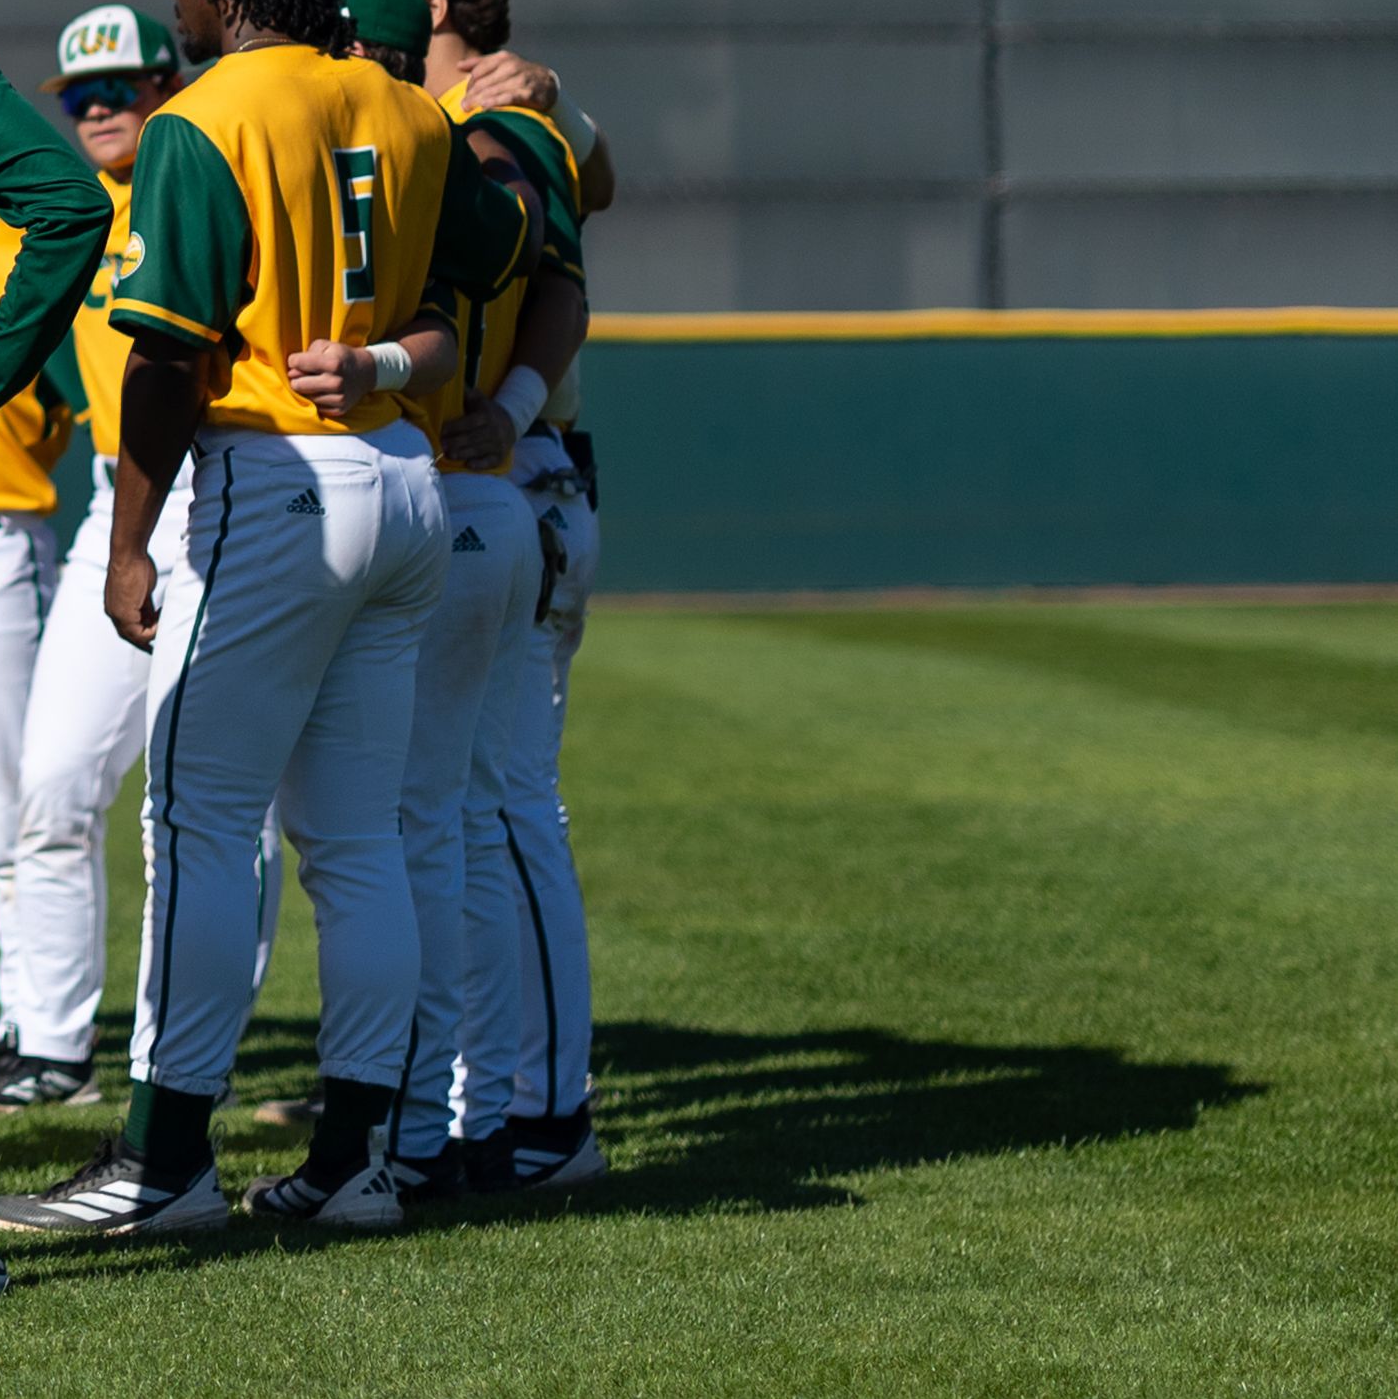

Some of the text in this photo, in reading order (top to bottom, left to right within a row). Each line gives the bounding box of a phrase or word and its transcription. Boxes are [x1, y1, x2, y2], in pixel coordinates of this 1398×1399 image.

[66, 23, 121, 62] CUI
[333, 144, 377, 304] 5
[286, 503, 326, 516] adidas
